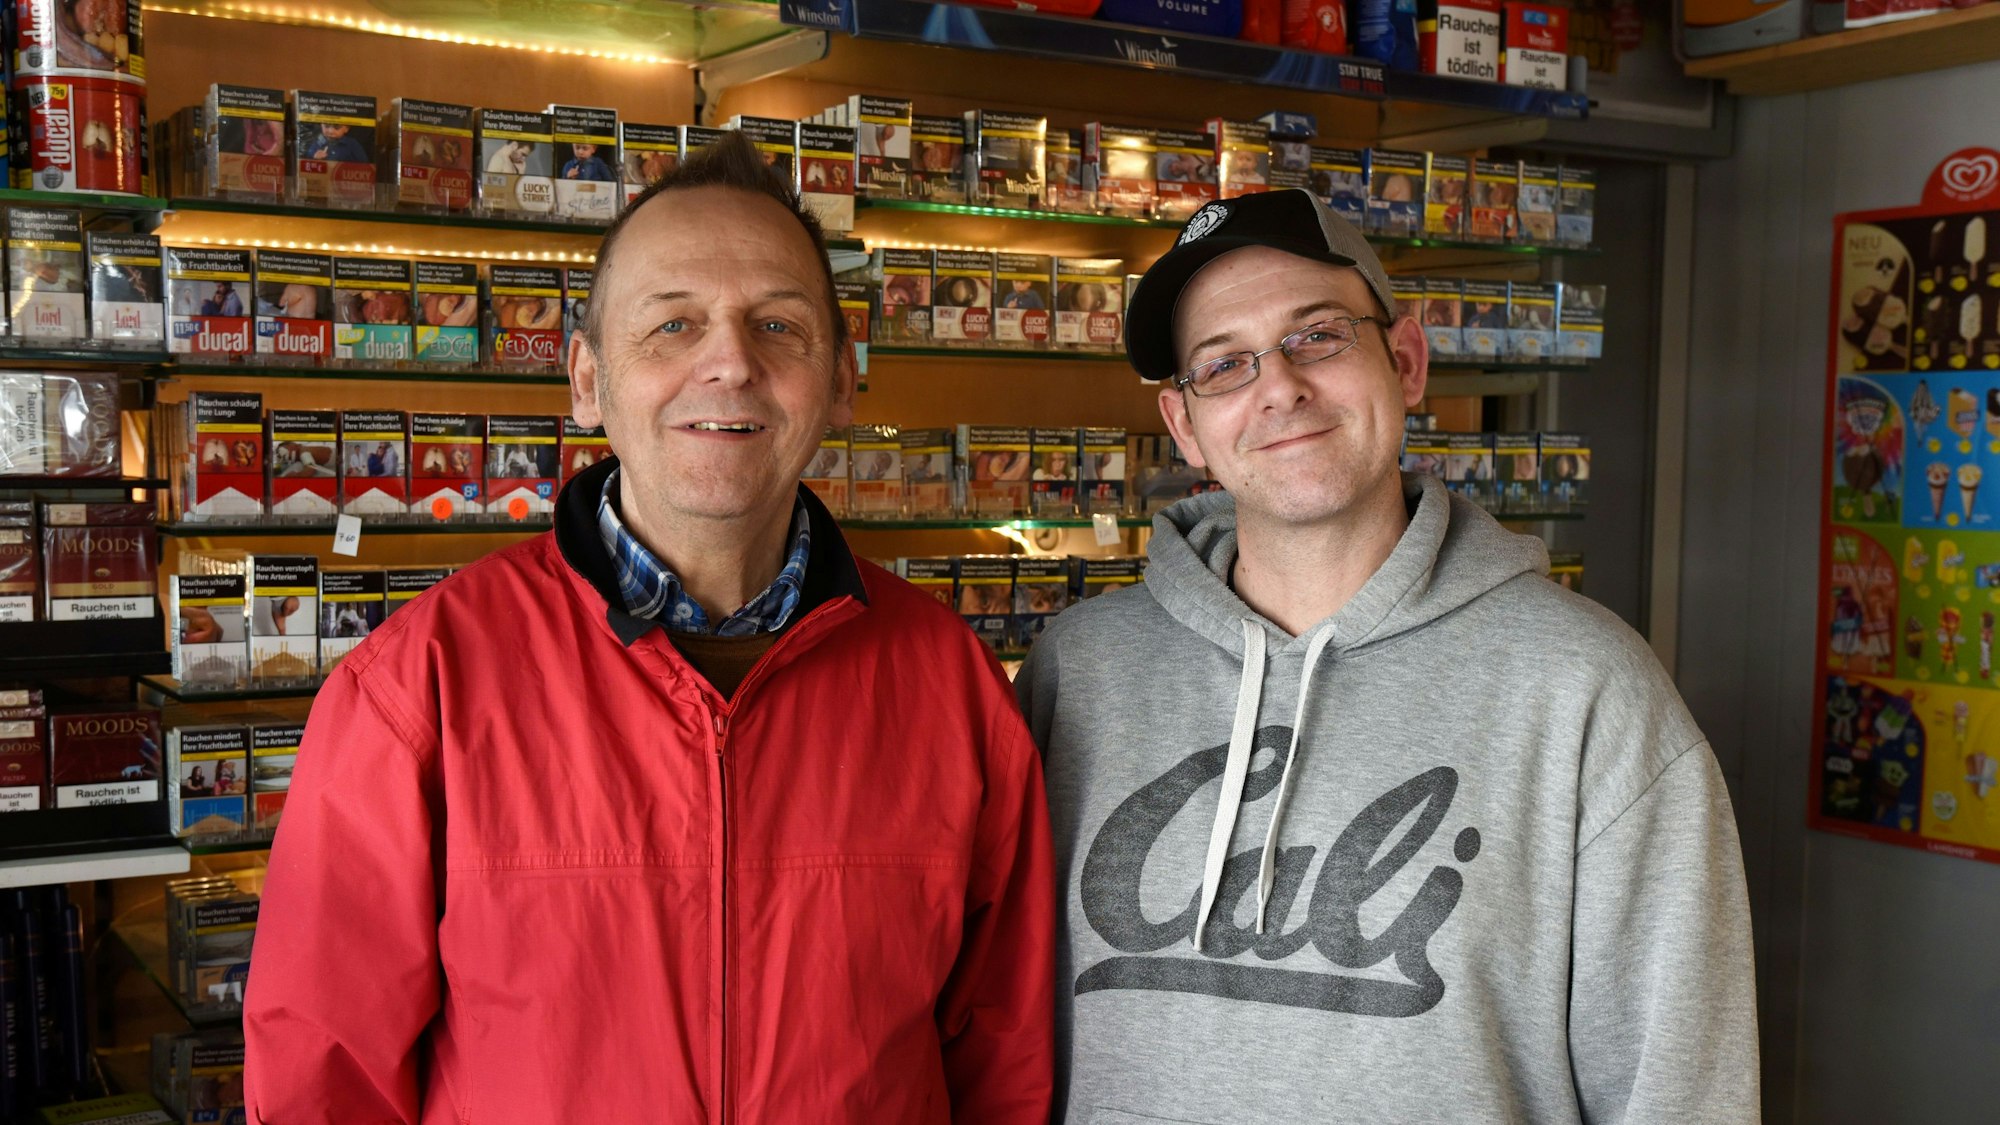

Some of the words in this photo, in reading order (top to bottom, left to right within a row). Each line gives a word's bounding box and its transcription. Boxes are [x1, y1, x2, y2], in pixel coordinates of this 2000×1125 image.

[796, 6, 841, 27] Winston
[1463, 37, 1481, 56] ist
[1124, 39, 1177, 68] Winston
[1519, 50, 1562, 64] Rauchen
[1338, 62, 1360, 78] STAY
[1360, 65, 1384, 82] TRUE
[1447, 57, 1494, 79] tödlich
[1534, 66, 1546, 78] ist
[51, 85, 65, 98] 75g
[403, 100, 435, 113] Rauchen
[420, 112, 442, 125] Lunge
[484, 111, 513, 122] Rauchen
[514, 113, 542, 124] bedroht
[484, 120, 498, 130] Ihre
[499, 122, 523, 132] Potenz
[36, 107, 72, 166] ducal
[802, 128, 828, 138] Rauchen
[815, 138, 834, 149] Lunge
[253, 163, 281, 175] LUCKY
[871, 166, 907, 183] Winston
[440, 176, 467, 188] LUCKY
[523, 183, 550, 193] LUCKY
[522, 193, 551, 204] STRIKE
[11, 210, 46, 220] Rauchen
[48, 212, 68, 221] kann
[24, 221, 78, 232] ungeborenes
[32, 231, 55, 240] töten
[93, 236, 122, 246] Rauchen
[123, 237, 145, 247] erhöht
[1849, 236, 1883, 250] NEU
[124, 246, 156, 256] erblinden
[207, 252, 240, 262] mindert
[259, 254, 284, 264] Rauchen
[189, 262, 245, 273] Fruchtbarkeit
[35, 306, 62, 327] Lord
[115, 310, 141, 329] Lord
[966, 314, 989, 323] LUCKY
[1025, 316, 1047, 325] LUCKY
[1024, 325, 1048, 335] STRIKE
[199, 320, 250, 352] ducal
[278, 323, 325, 354] ducal
[365, 330, 409, 360] ducal
[198, 399, 229, 408] Rauchen
[229, 400, 260, 410] schädigt
[198, 408, 213, 417] Ihre
[213, 409, 237, 418] Lunge
[344, 414, 373, 422] Rauchen
[373, 414, 400, 422] mindert
[359, 422, 402, 430] Fruchtbarkeit
[413, 416, 439, 425] Rauchen
[440, 417, 466, 426] schädigt
[426, 425, 446, 434] Lunge
[61, 537, 143, 554] MOODS
[255, 564, 285, 573] Rauchen
[285, 564, 315, 573] verstopft
[180, 578, 209, 587] Rauchen
[209, 578, 237, 587] schädigt
[255, 573, 269, 581] Ihre
[270, 573, 298, 581] Arterien
[180, 587, 195, 595] Ihre
[195, 588, 216, 597] Lunge
[71, 603, 120, 613] Rauchen
[123, 602, 136, 612] ist
[66, 718, 149, 736] MOODS
[182, 734, 213, 743] Rauchen
[213, 733, 241, 741] mindert
[255, 729, 284, 737] Rauchen
[182, 743, 197, 751] Ihre
[198, 741, 244, 751] Fruchtbarkeit
[255, 738, 269, 746] Ihre
[75, 788, 125, 799] Rauchen
[127, 786, 141, 796] ist
[1078, 725, 1482, 985] Cali
[198, 908, 227, 918] Rauchen
[212, 915, 241, 924] Arterien
